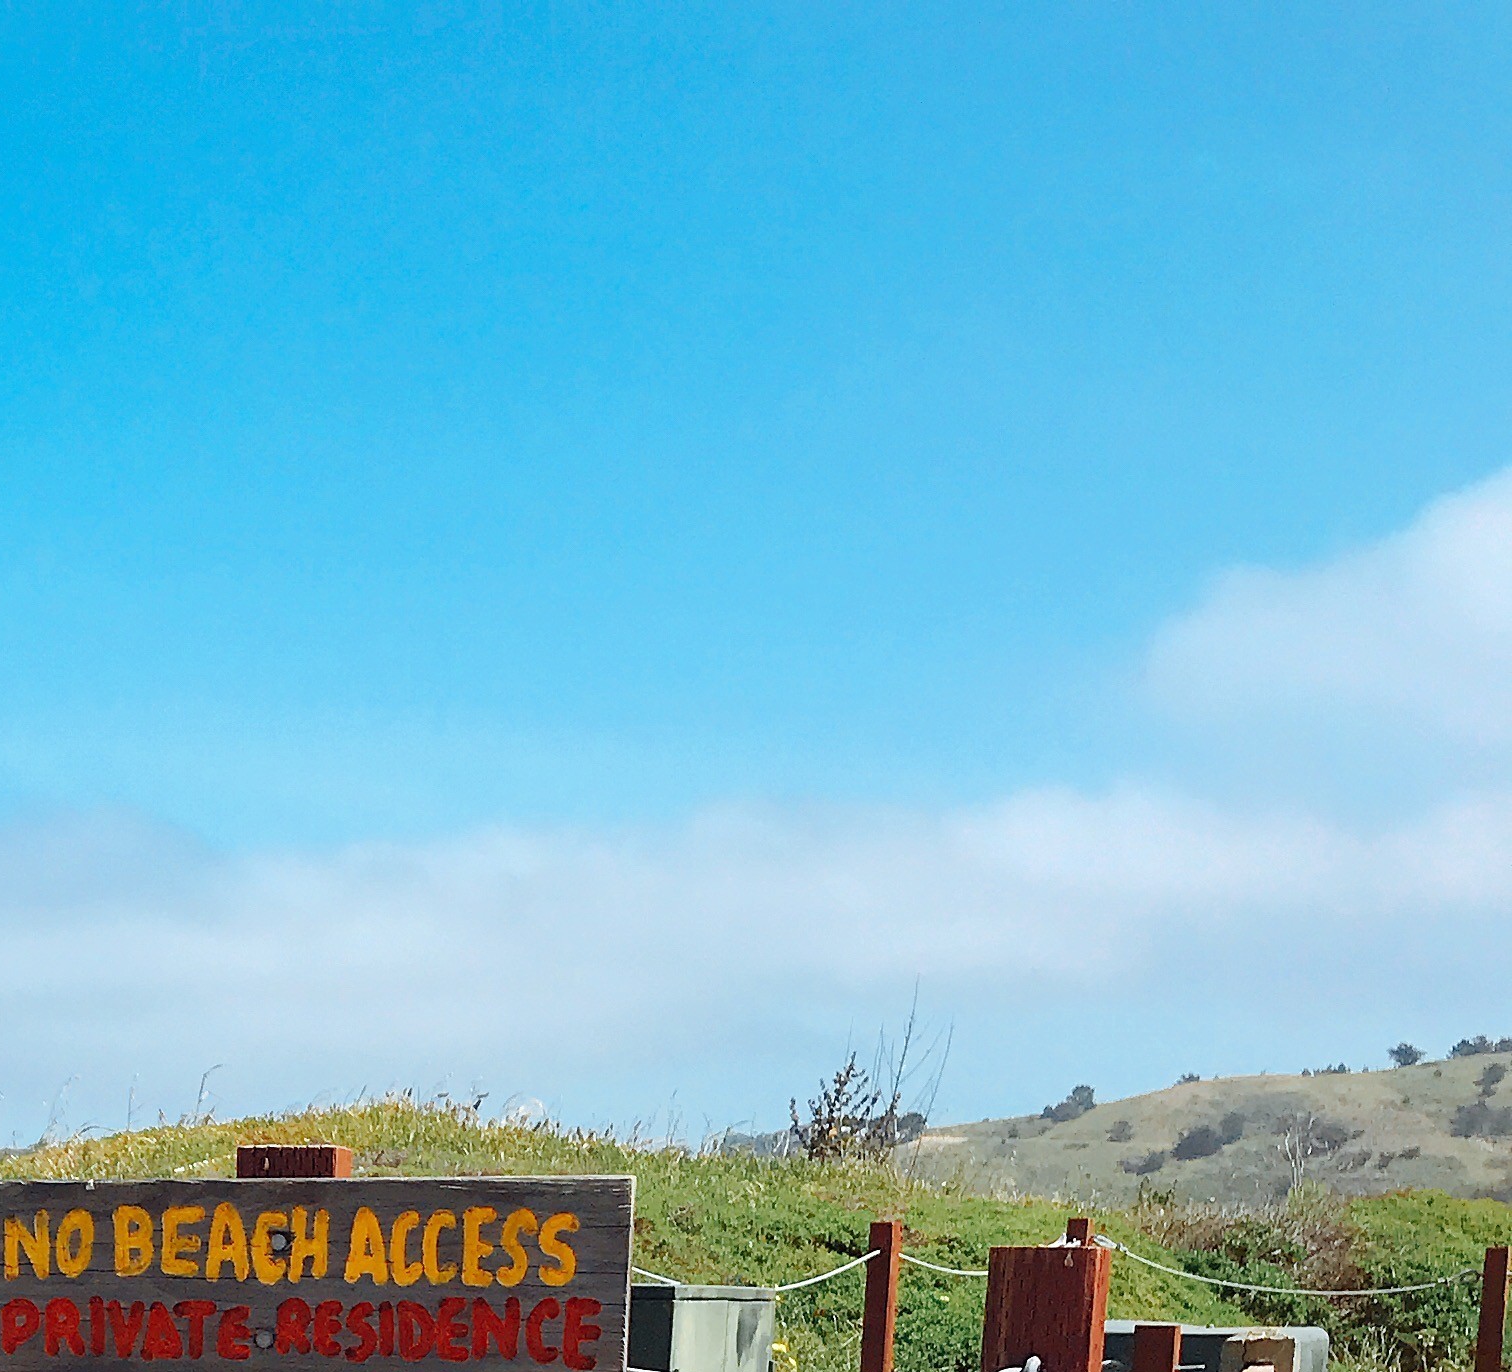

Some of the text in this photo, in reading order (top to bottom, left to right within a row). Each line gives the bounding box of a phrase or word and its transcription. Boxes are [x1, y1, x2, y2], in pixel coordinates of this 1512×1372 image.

[3, 1202, 579, 1287] NO BEACH ACCESS
[1, 1296, 603, 1371] PRIVATE RESIDENCE
